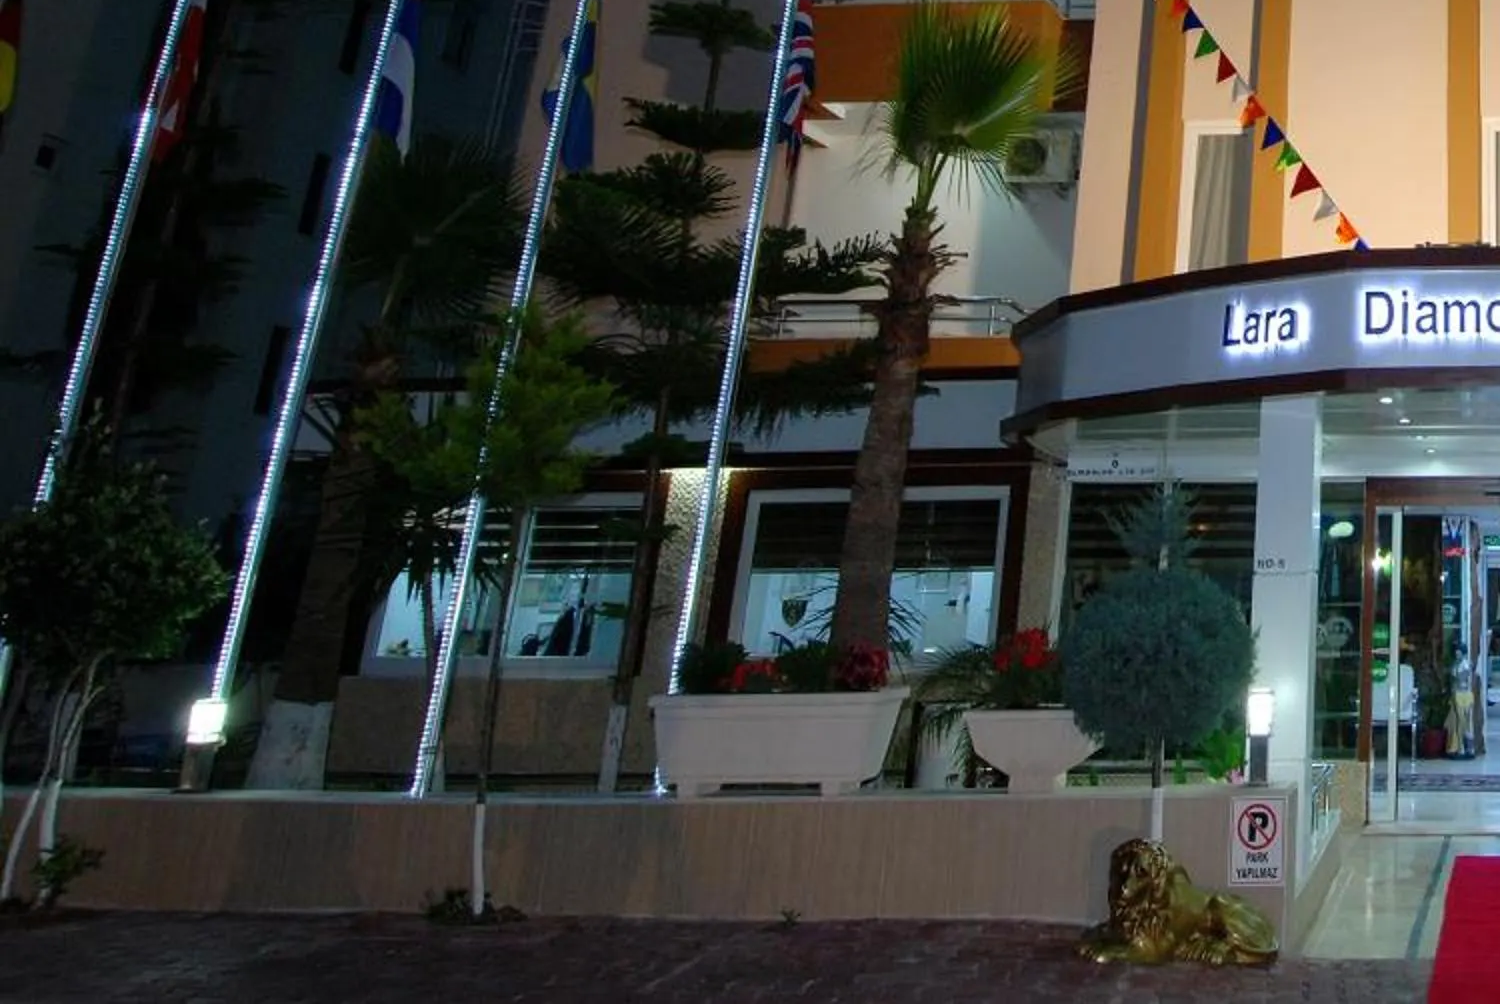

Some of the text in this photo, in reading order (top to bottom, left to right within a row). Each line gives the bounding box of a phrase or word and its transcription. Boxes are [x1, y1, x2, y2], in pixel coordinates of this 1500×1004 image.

[1221, 301, 1298, 347] Lara
[1246, 851, 1270, 864] PARK
[1236, 867, 1278, 879] YAPILMAZ
